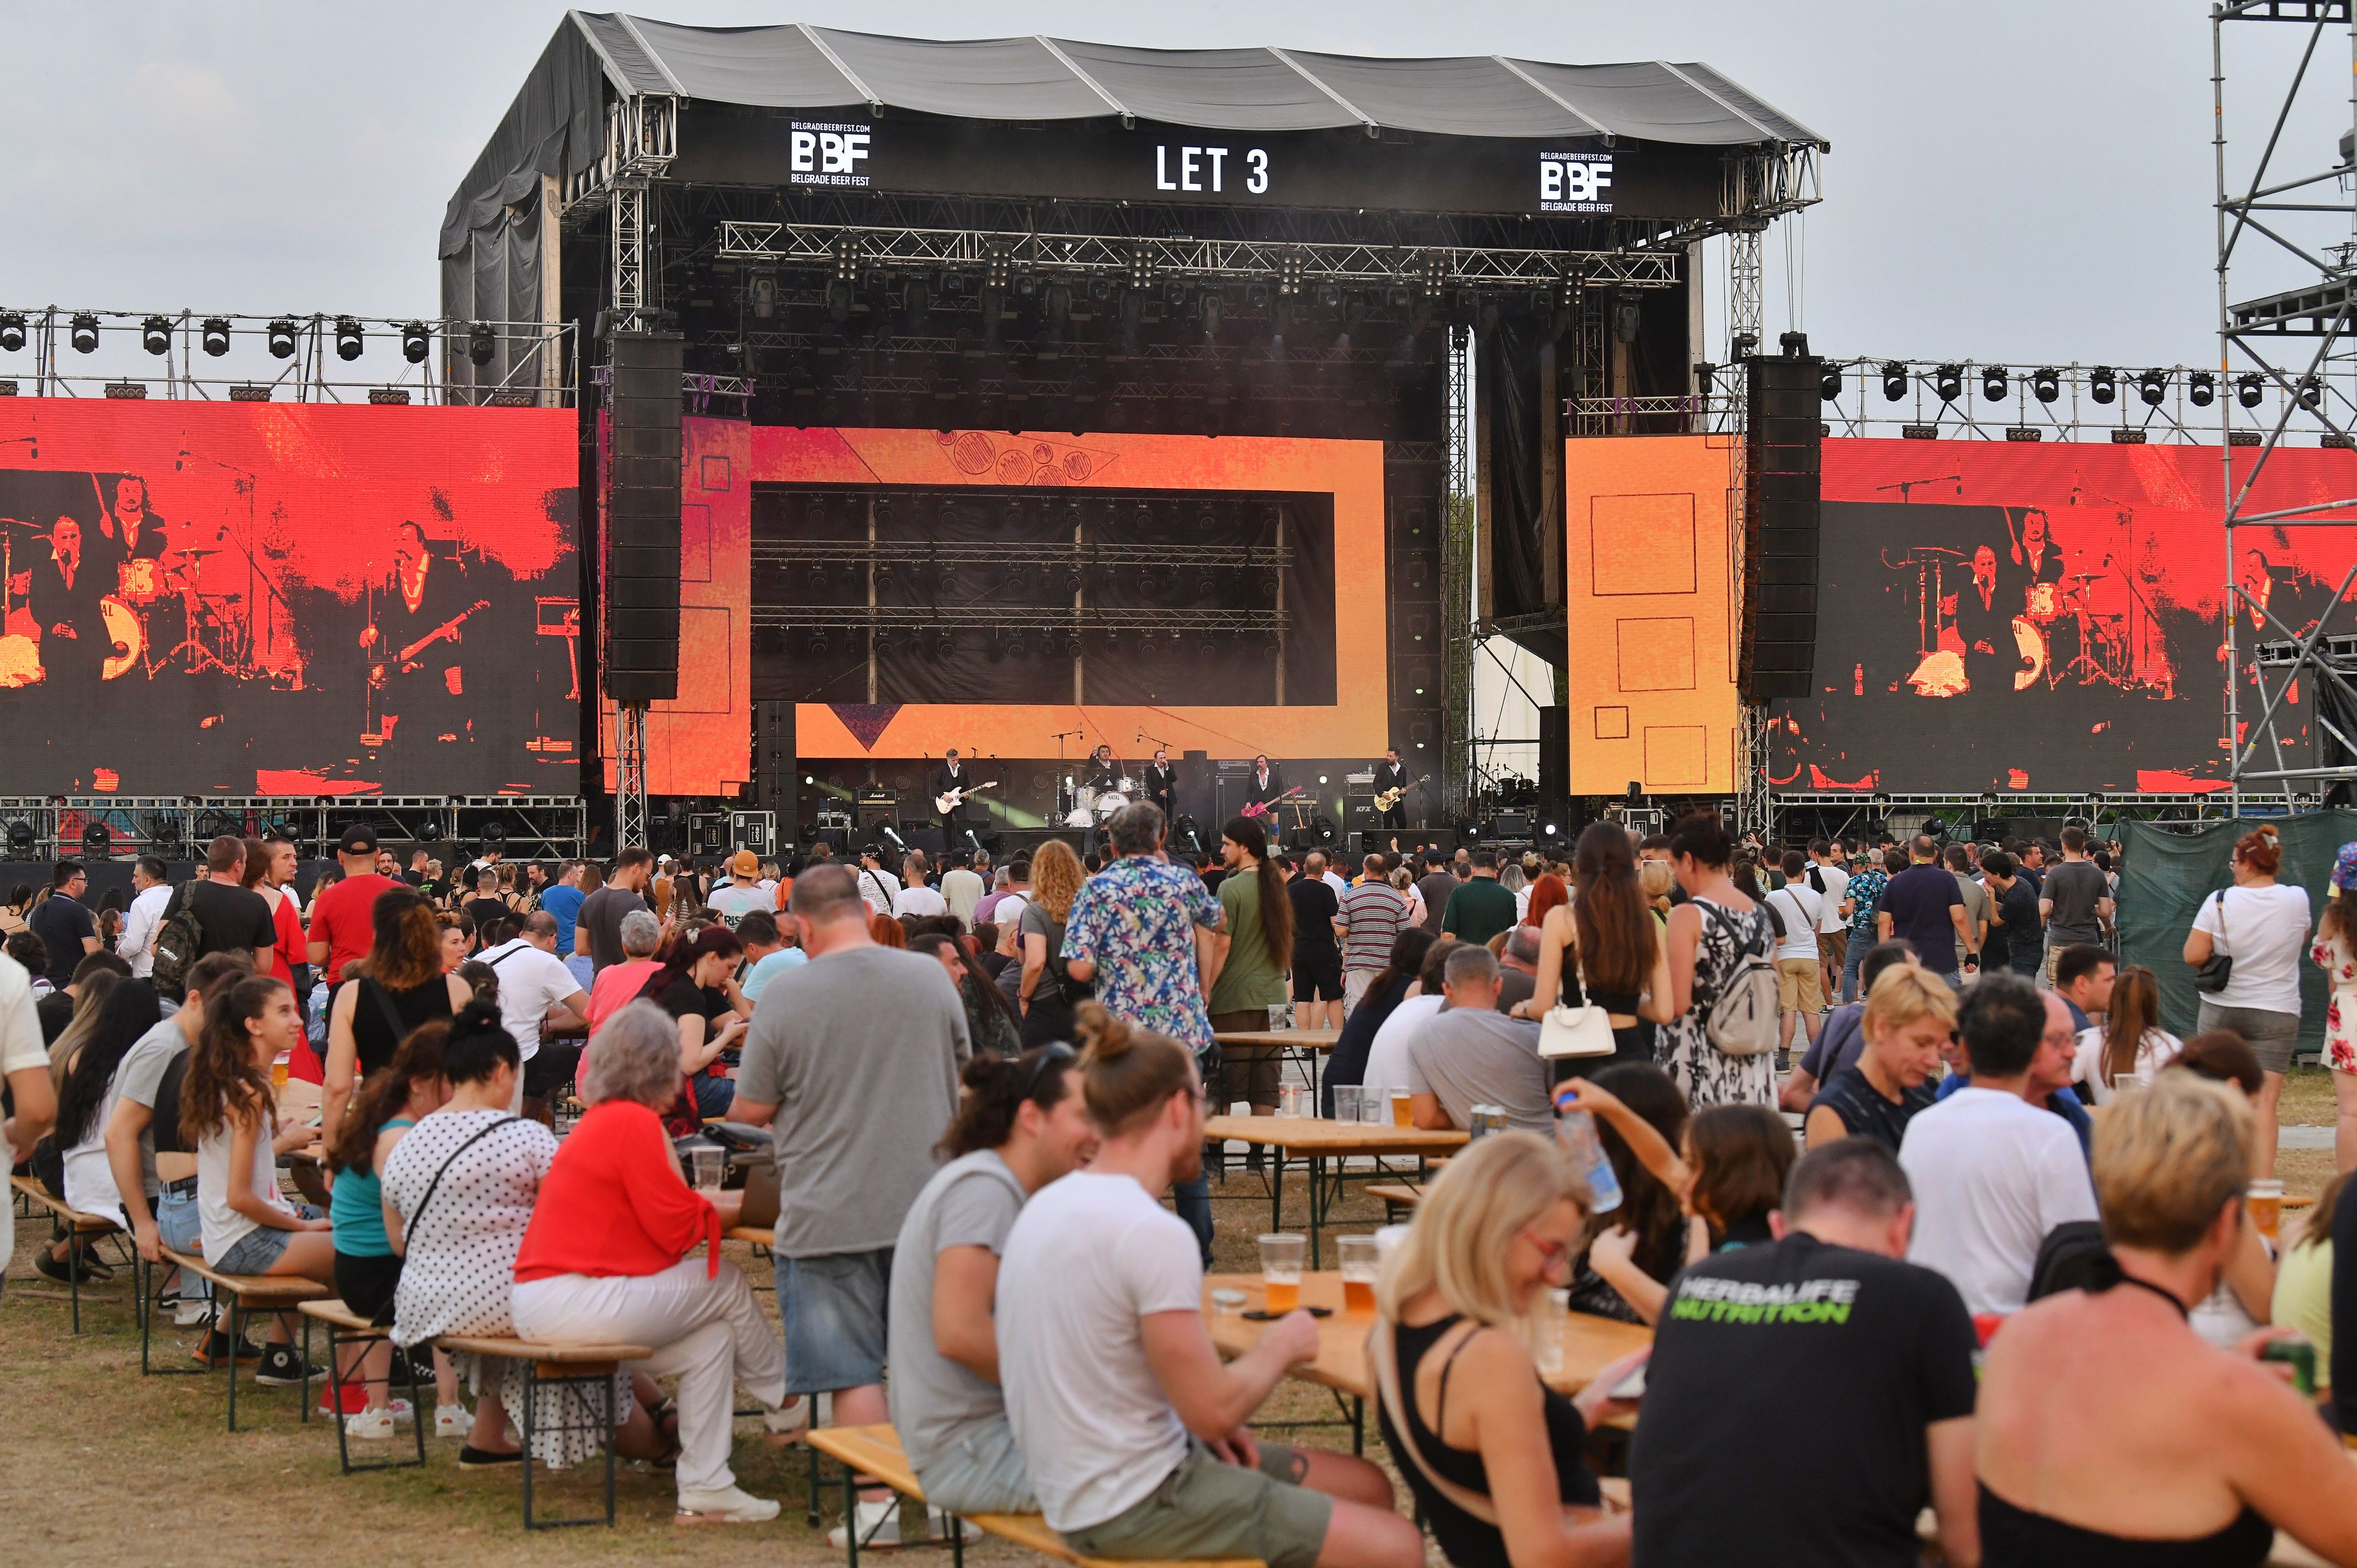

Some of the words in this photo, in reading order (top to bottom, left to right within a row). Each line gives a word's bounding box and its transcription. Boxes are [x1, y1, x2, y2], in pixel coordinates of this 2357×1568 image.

[791, 122, 870, 133] BELGRADEBEERFEST.COM
[791, 131, 870, 173] BBF
[1540, 152, 1612, 161] BELGRADEBEERFEST.COM
[1157, 146, 1228, 192] LET
[1246, 148, 1268, 194] 3
[791, 174, 829, 184] BELGRADE
[831, 175, 850, 185] BEER
[852, 176, 870, 186] FEST
[1541, 161, 1613, 201] BBF
[1541, 202, 1576, 212] BELGRADE
[1578, 203, 1595, 212] BEER
[1596, 204, 1613, 213] FEST
[724, 915, 743, 926] RIS
[1678, 1276, 1860, 1305] HERBALIFE
[1671, 1298, 1853, 1324] NUTRITION
